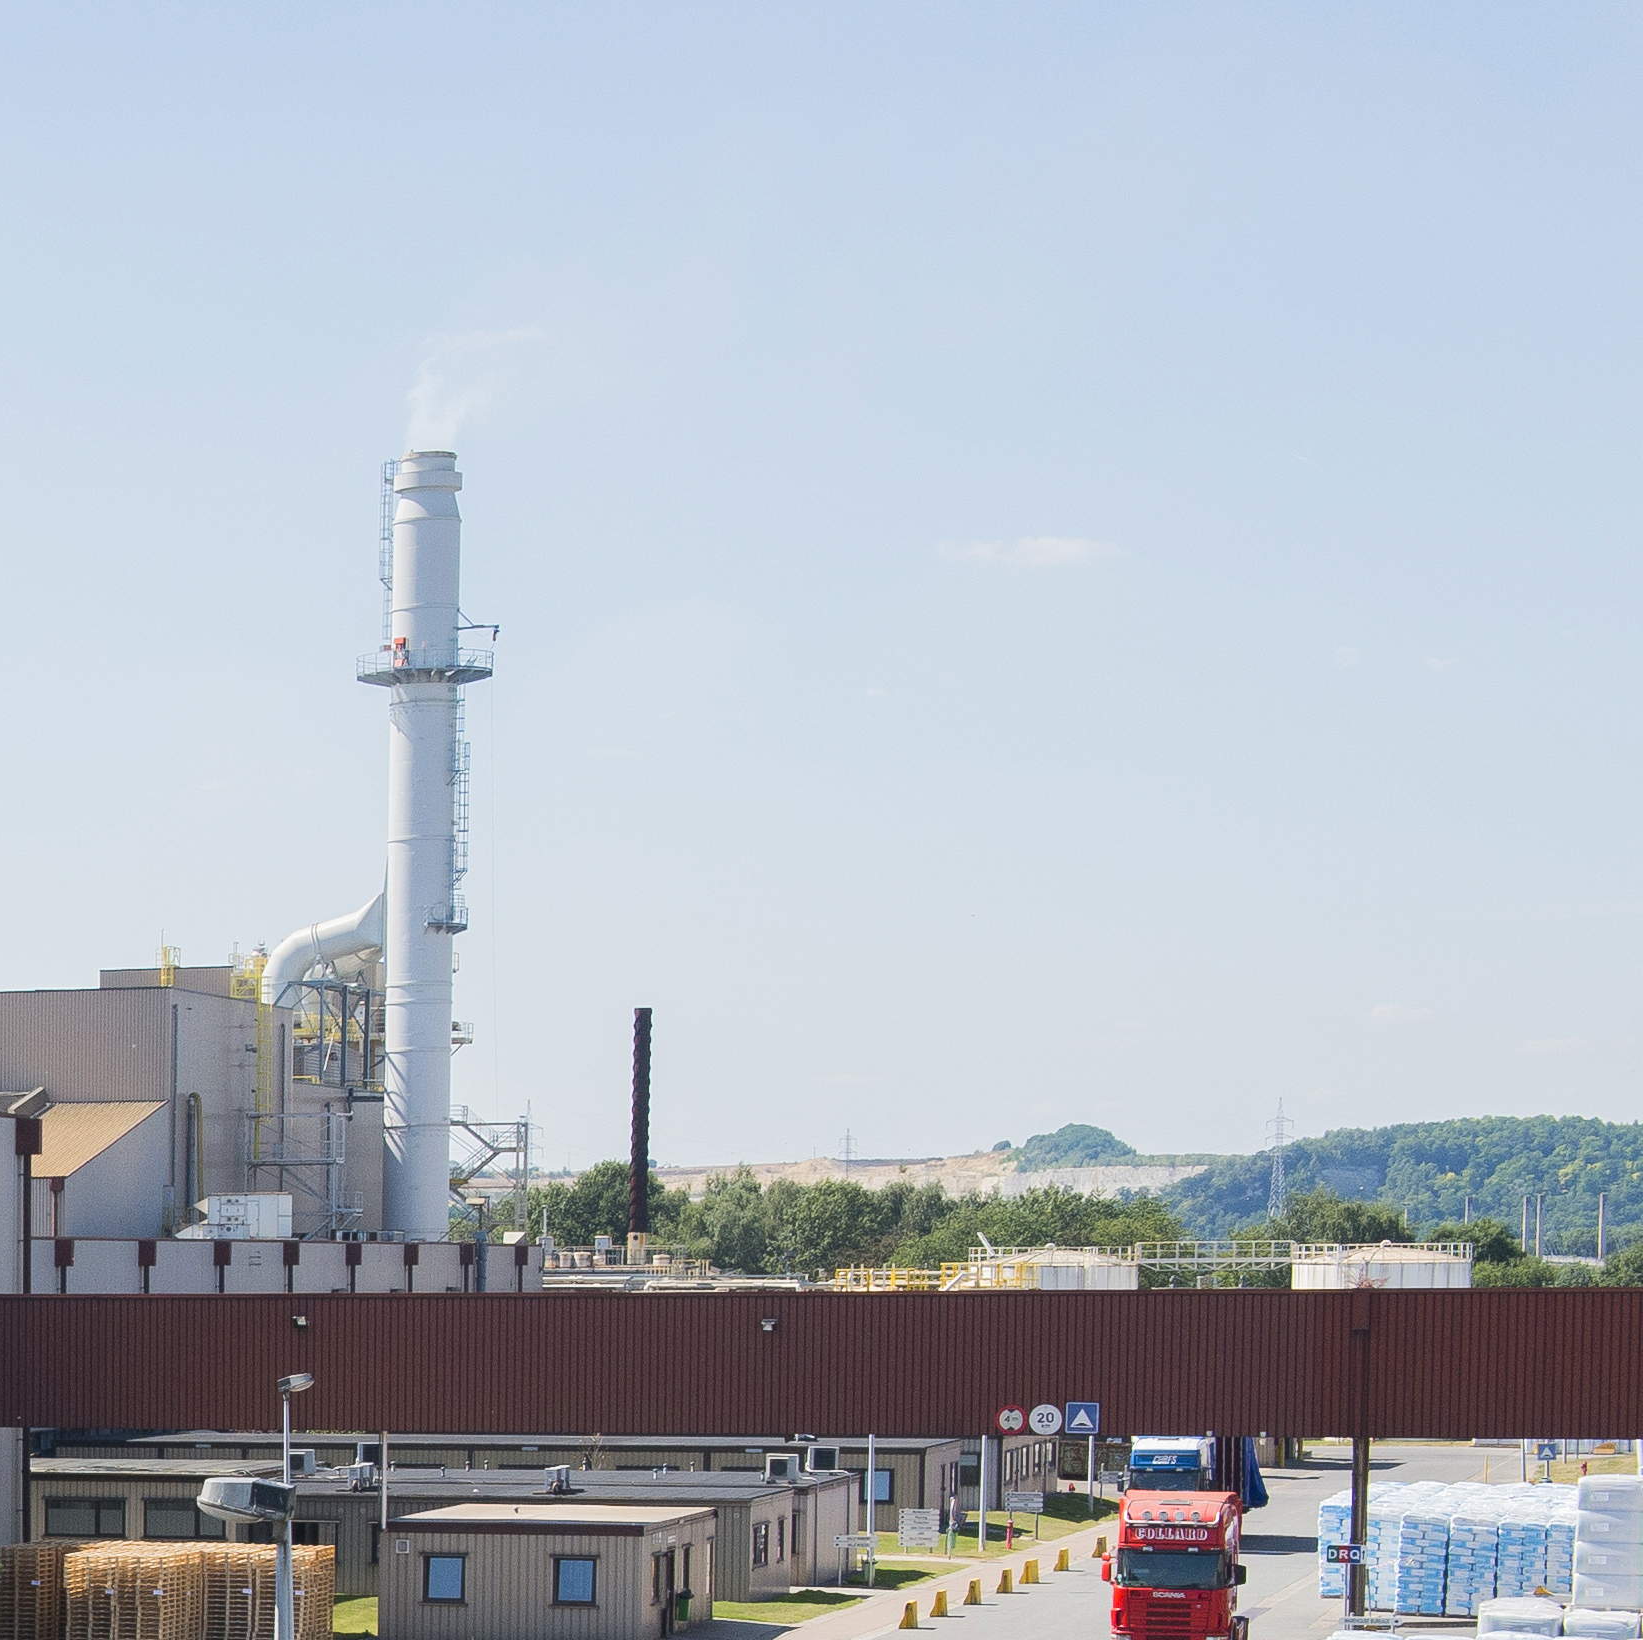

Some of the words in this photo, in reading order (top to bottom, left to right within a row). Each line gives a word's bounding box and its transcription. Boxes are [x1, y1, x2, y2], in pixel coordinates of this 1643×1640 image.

[1037, 1412, 1055, 1424] 20
[1135, 1527, 1208, 1540] COLLARD
[1328, 1549, 1360, 1560] DRQ
